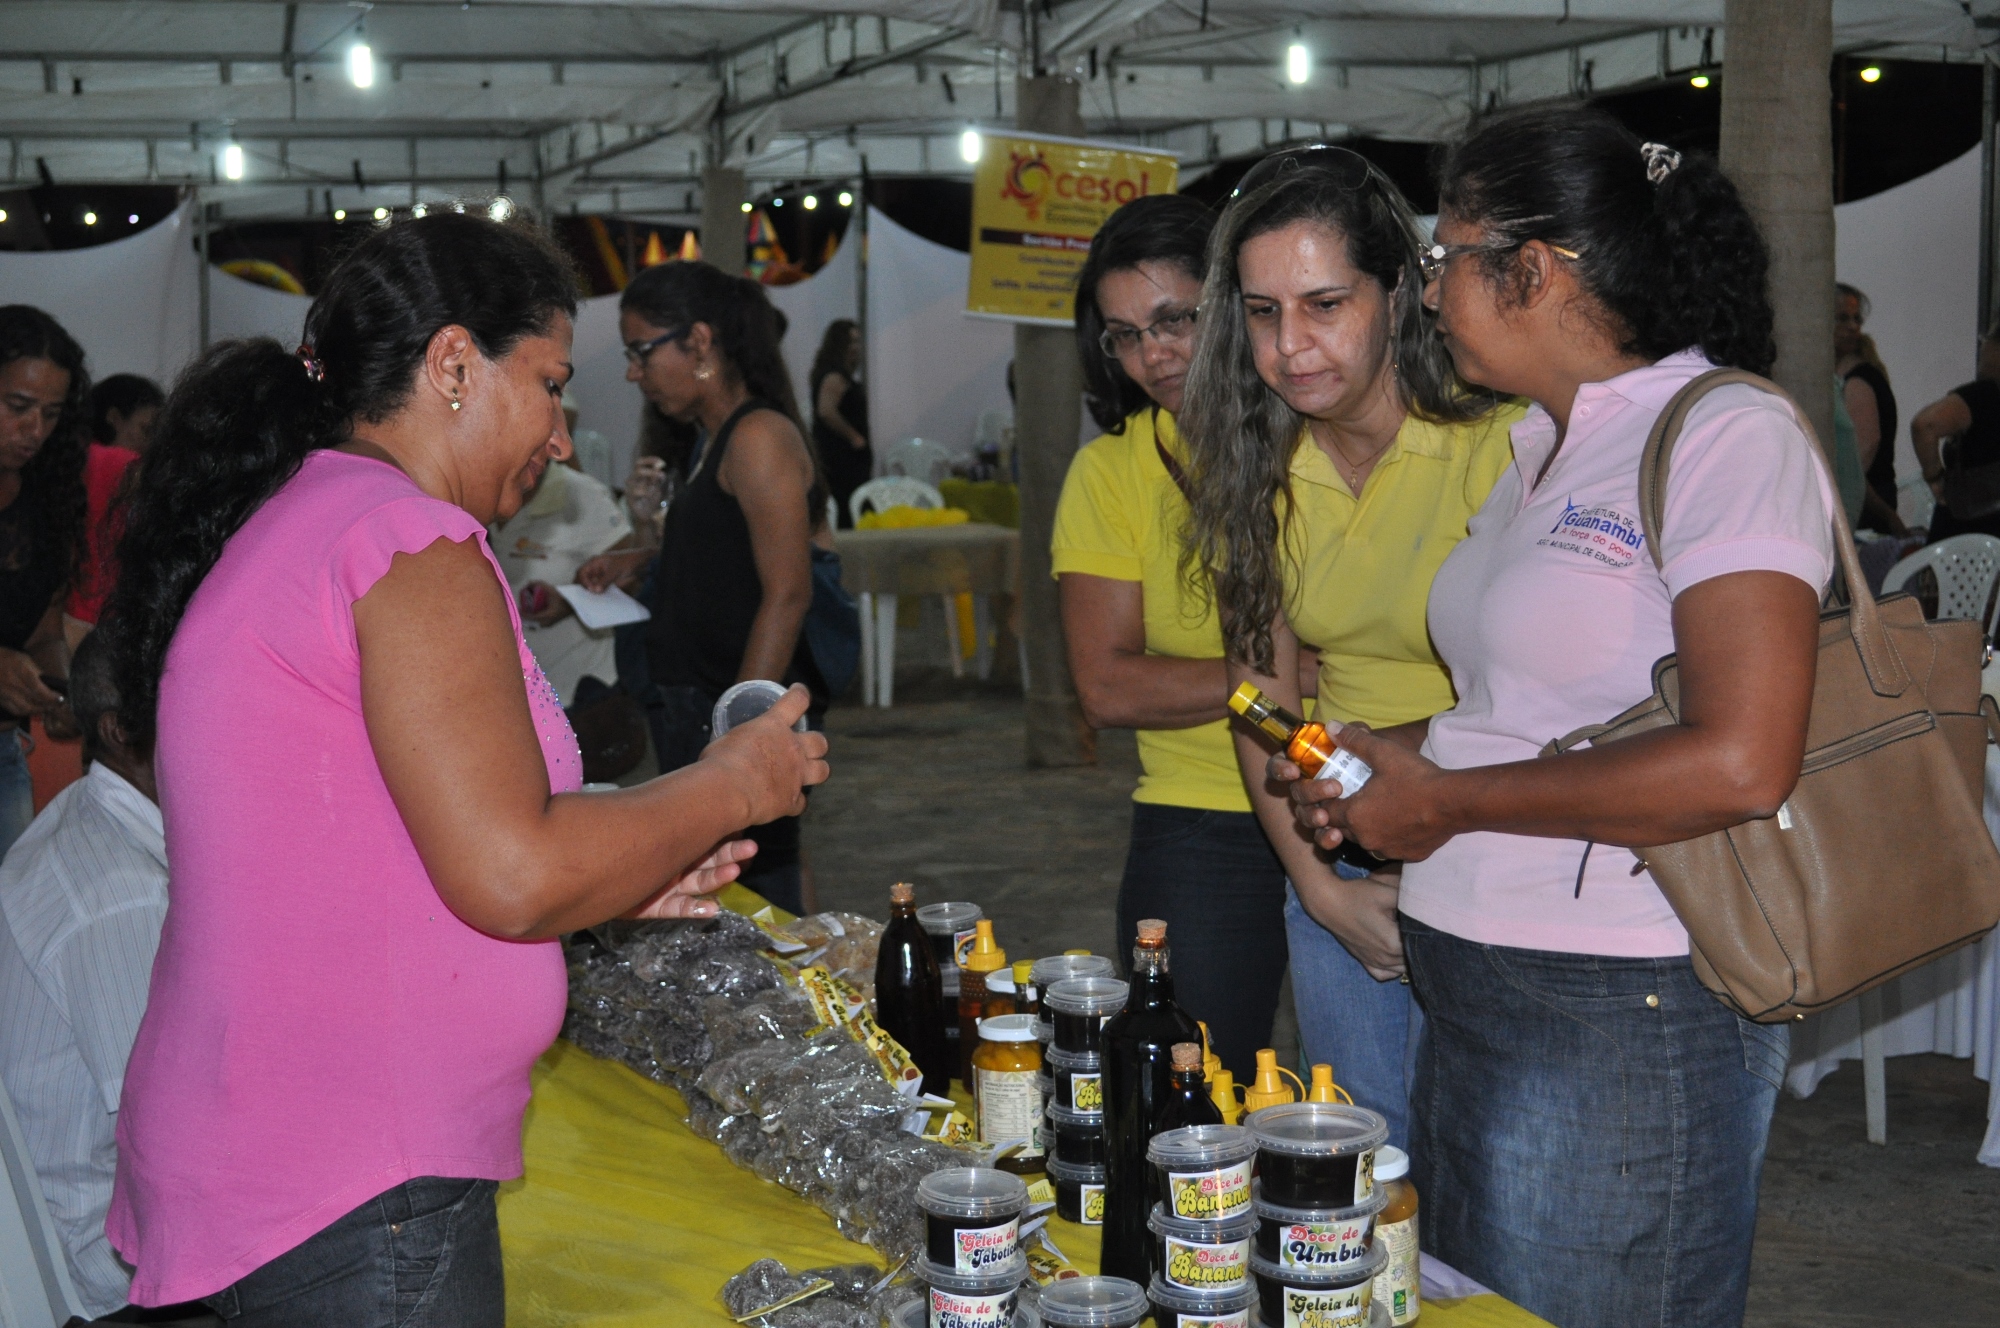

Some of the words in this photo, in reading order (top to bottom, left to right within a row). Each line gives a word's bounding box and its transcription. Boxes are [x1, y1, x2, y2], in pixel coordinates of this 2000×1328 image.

[1564, 512, 1645, 550] Guanambi
[1622, 517, 1635, 529] DE
[1581, 546, 1594, 557] DE
[1592, 535, 1607, 545] do
[1608, 542, 1632, 559] povo
[1201, 1176, 1231, 1193] Doce
[1233, 1172, 1243, 1185] de
[1176, 1184, 1250, 1216] Banana
[960, 1233, 1003, 1252] Geleia
[1006, 1227, 1015, 1241] de
[1288, 1225, 1337, 1243] Doce
[1341, 1226, 1359, 1241] de
[1196, 1249, 1226, 1263] Doce
[1229, 1250, 1239, 1261] de
[1169, 1252, 1244, 1283] Banana
[932, 1292, 972, 1314] Geleia
[976, 1301, 991, 1314] de
[1289, 1293, 1342, 1313] Geleia
[1346, 1292, 1359, 1307] de
